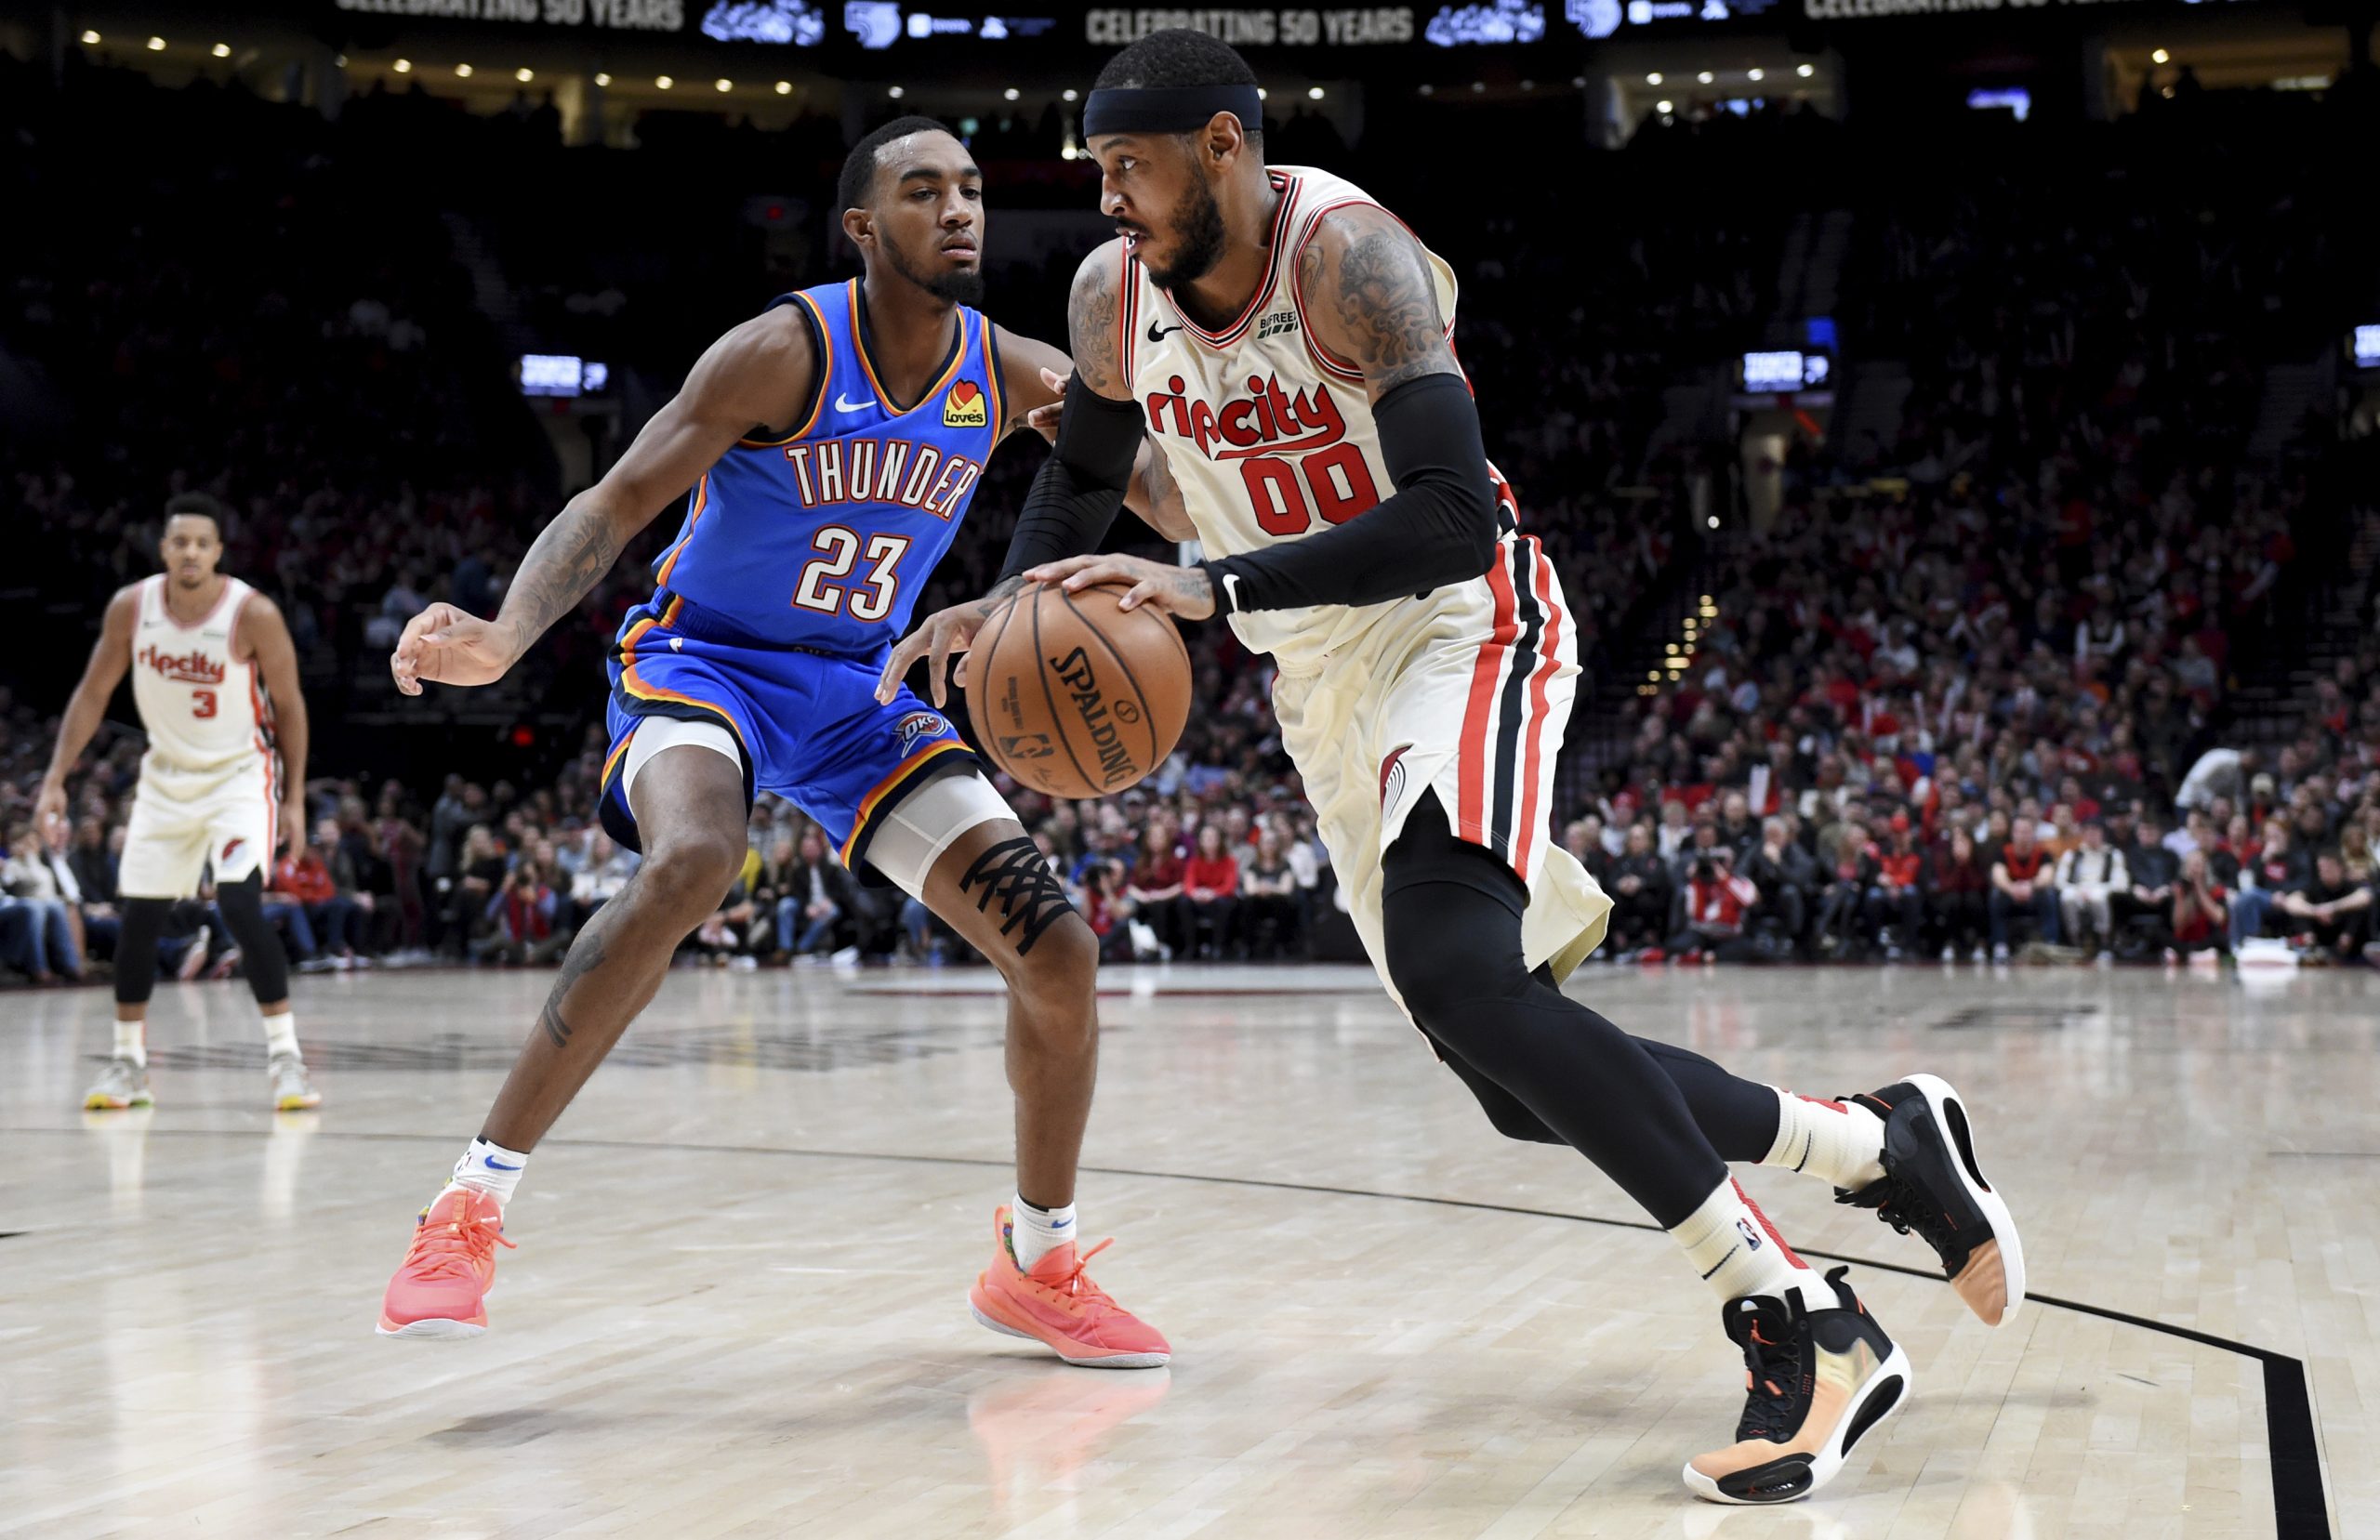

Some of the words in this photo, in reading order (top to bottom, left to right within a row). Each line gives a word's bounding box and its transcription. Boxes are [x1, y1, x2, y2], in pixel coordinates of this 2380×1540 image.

[1280, 8, 1319, 46] 50
[1322, 7, 1414, 45] YEARS
[783, 439, 984, 521] THUNDER
[1239, 441, 1381, 536] 00
[791, 523, 913, 624] 23
[192, 690, 218, 719] 3
[1050, 646, 1139, 788] SPALDING
